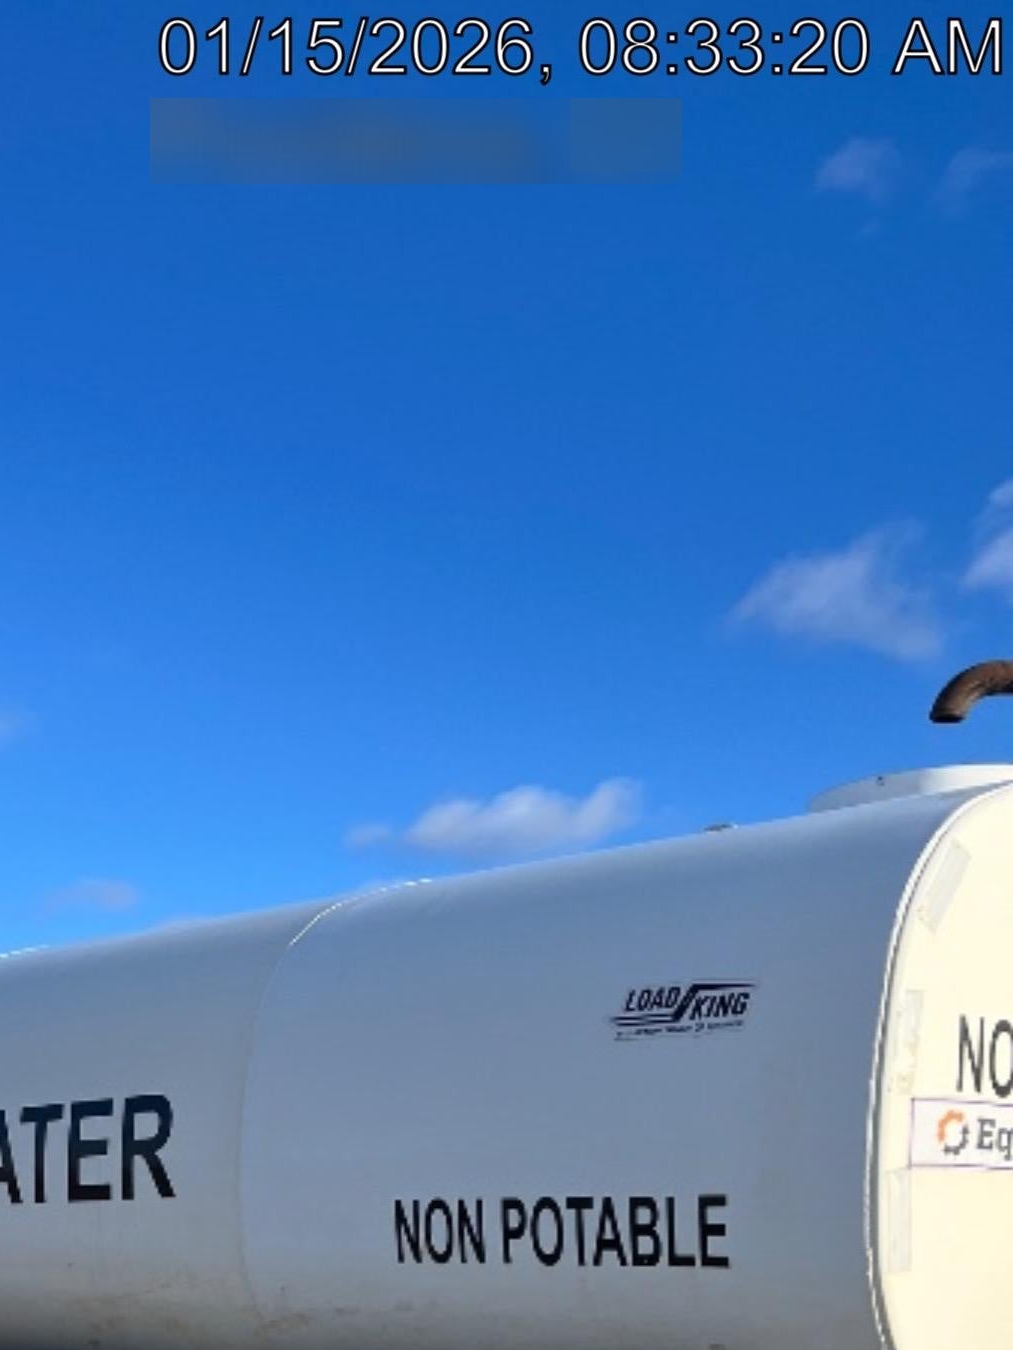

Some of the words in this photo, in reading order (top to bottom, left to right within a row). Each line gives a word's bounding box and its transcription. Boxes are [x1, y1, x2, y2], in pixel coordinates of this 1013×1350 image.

[625, 986, 681, 1013] LOAD
[689, 992, 750, 1021] KING
[394, 1197, 486, 1264] NON
[500, 1194, 730, 1268] POTABLE
